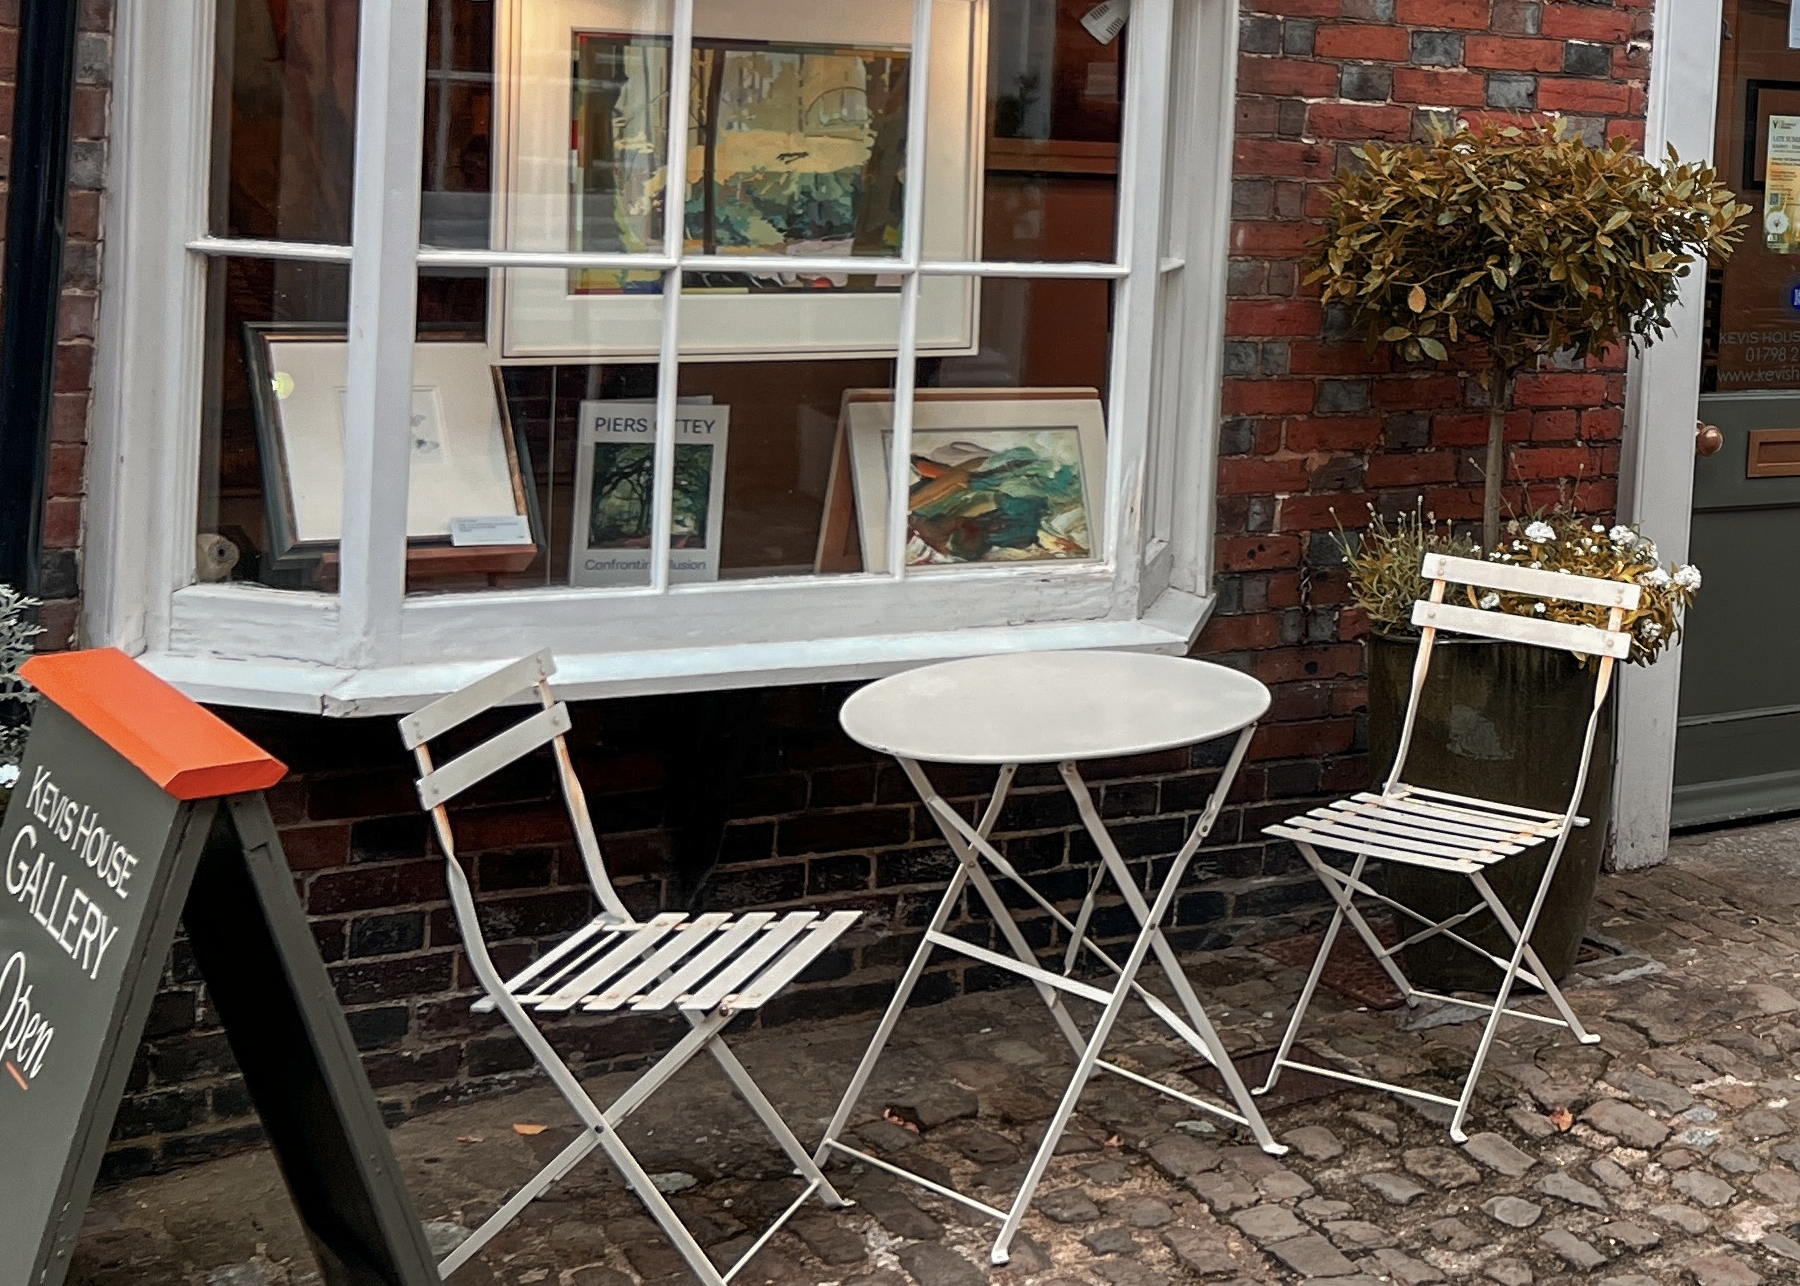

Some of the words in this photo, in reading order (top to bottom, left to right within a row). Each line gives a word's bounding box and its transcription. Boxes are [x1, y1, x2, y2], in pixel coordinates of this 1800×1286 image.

[1719, 331, 1759, 345] KEVIS
[1745, 347, 1787, 362] 01798
[595, 417, 648, 432] PIERS
[26, 765, 79, 843] KEVIS
[71, 804, 139, 900] HOUSE
[5, 825, 119, 980] GALLERY
